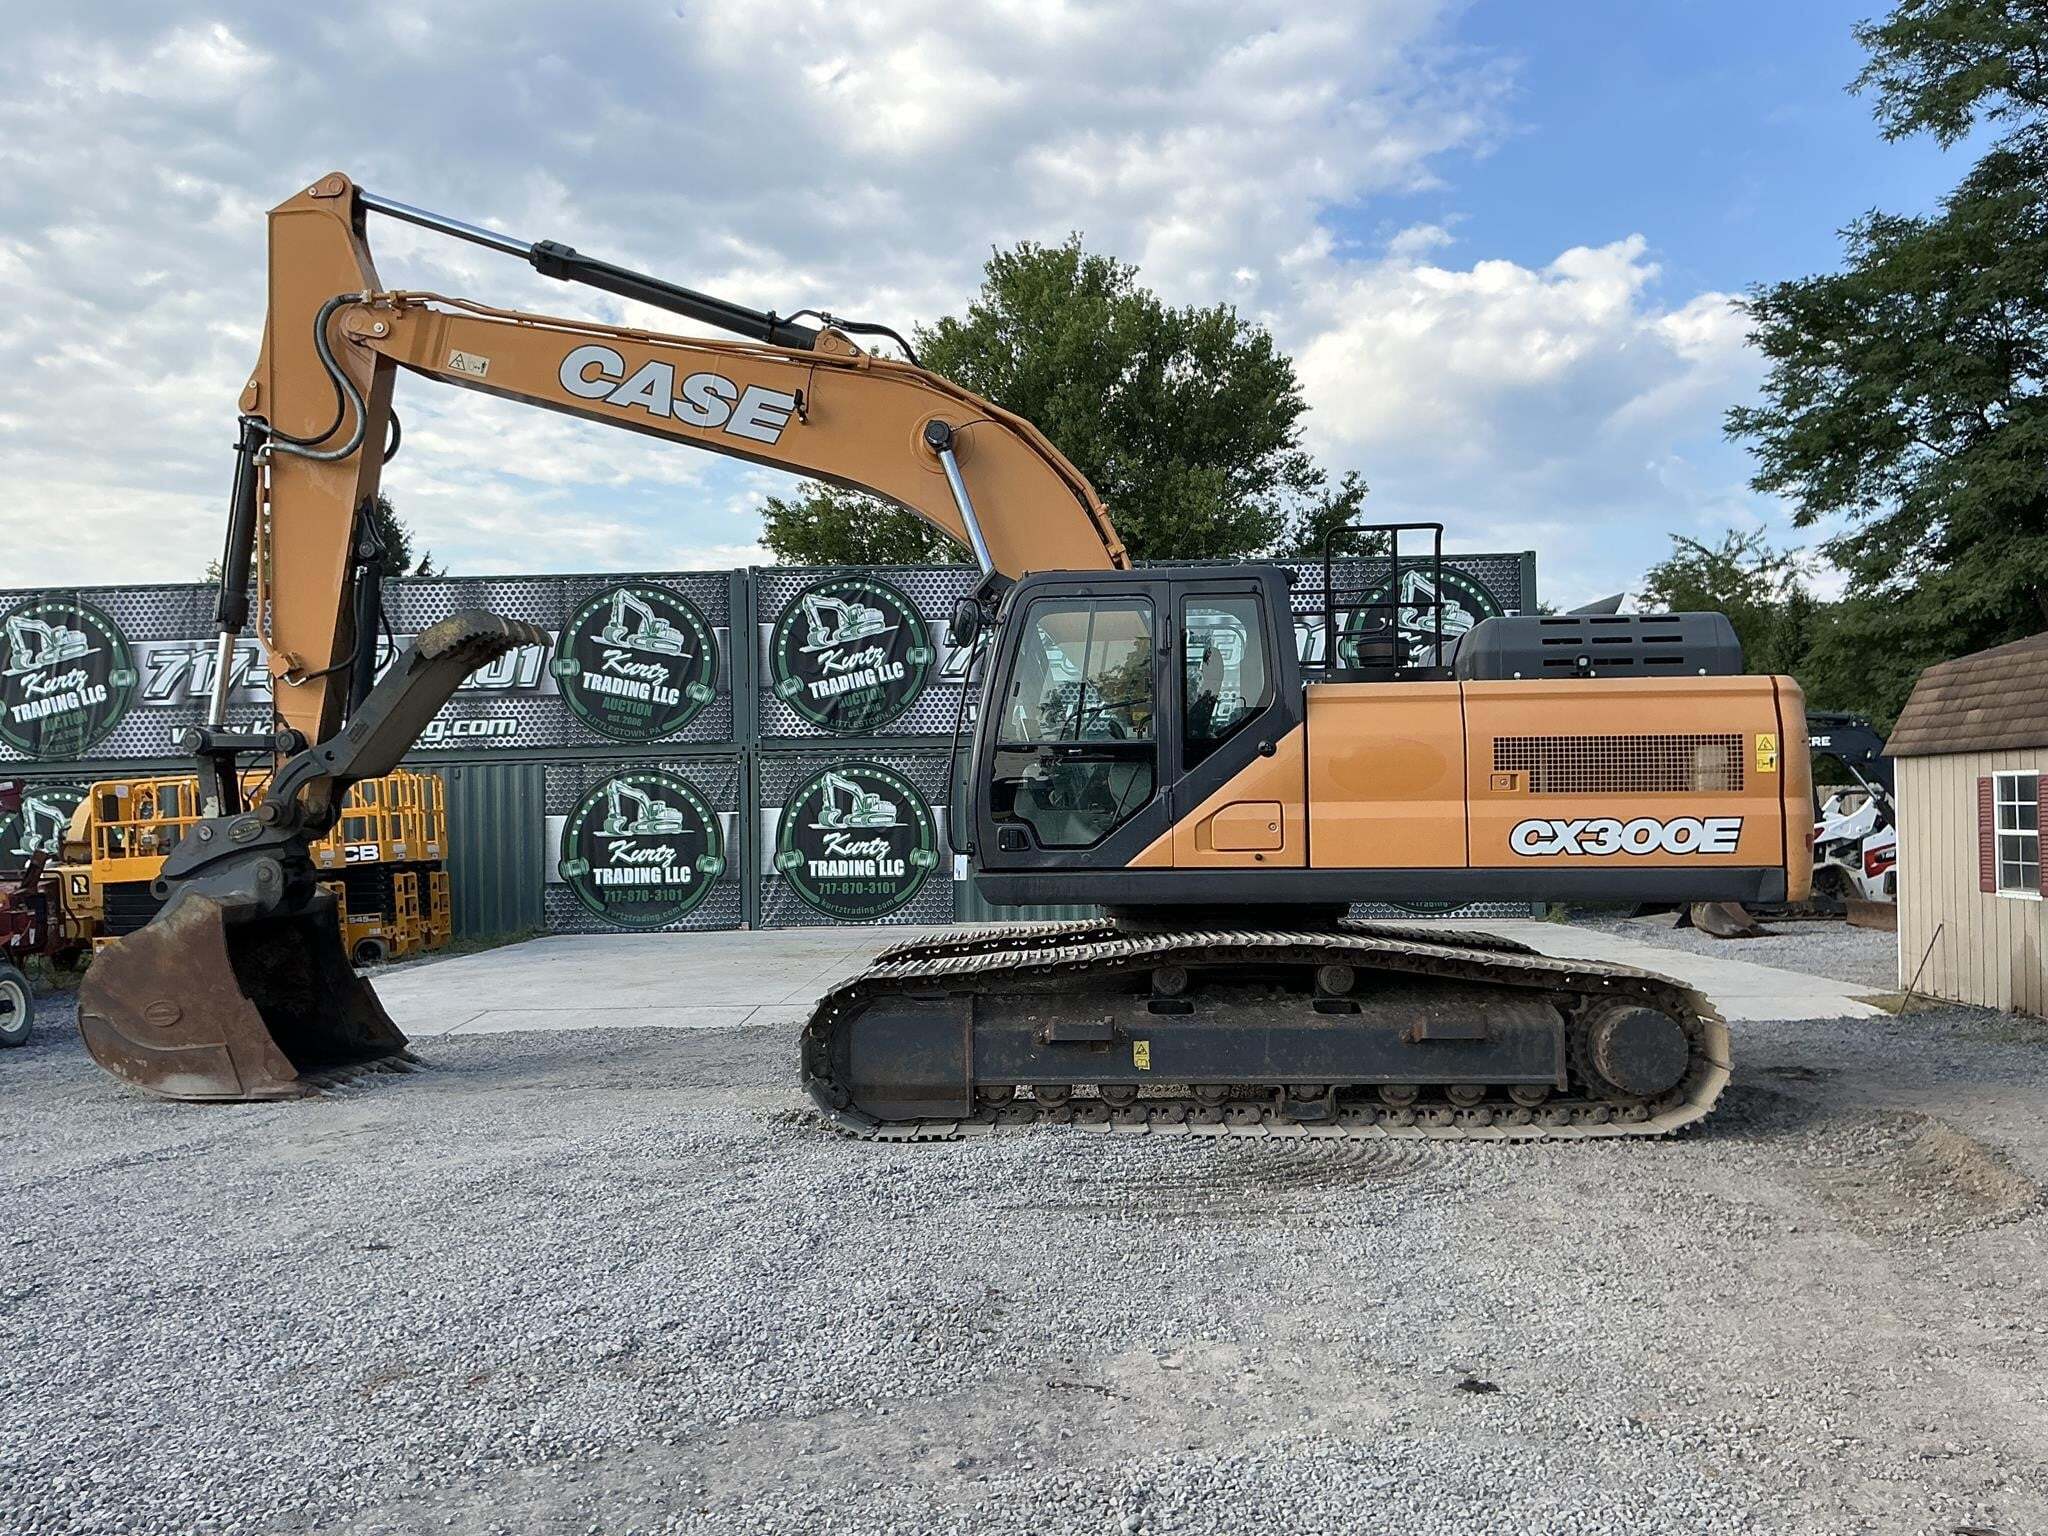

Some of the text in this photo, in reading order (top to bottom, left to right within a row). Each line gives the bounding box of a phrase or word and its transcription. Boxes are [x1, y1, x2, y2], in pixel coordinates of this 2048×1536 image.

[559, 344, 797, 445] CASE
[602, 649, 670, 686] Kurtz
[817, 645, 886, 675] Kurtz
[20, 668, 88, 698] Kurtz
[582, 672, 680, 705] TRADING LLC
[808, 661, 905, 699] TRADING LLC
[10, 684, 107, 723] TRADING LLC
[602, 696, 653, 717] AUCTION
[1808, 736, 1831, 747] RE
[823, 832, 891, 861] Kurtz
[1509, 816, 1744, 856] CX300E
[345, 845, 380, 862] CB
[608, 839, 677, 868] Kurtz
[808, 859, 905, 877] TRADING LLC
[593, 866, 691, 885] TRADING LLC
[818, 882, 896, 895] 717-870-3101
[604, 889, 682, 903] 717-870-3101
[821, 898, 894, 914] kurtztrading.com
